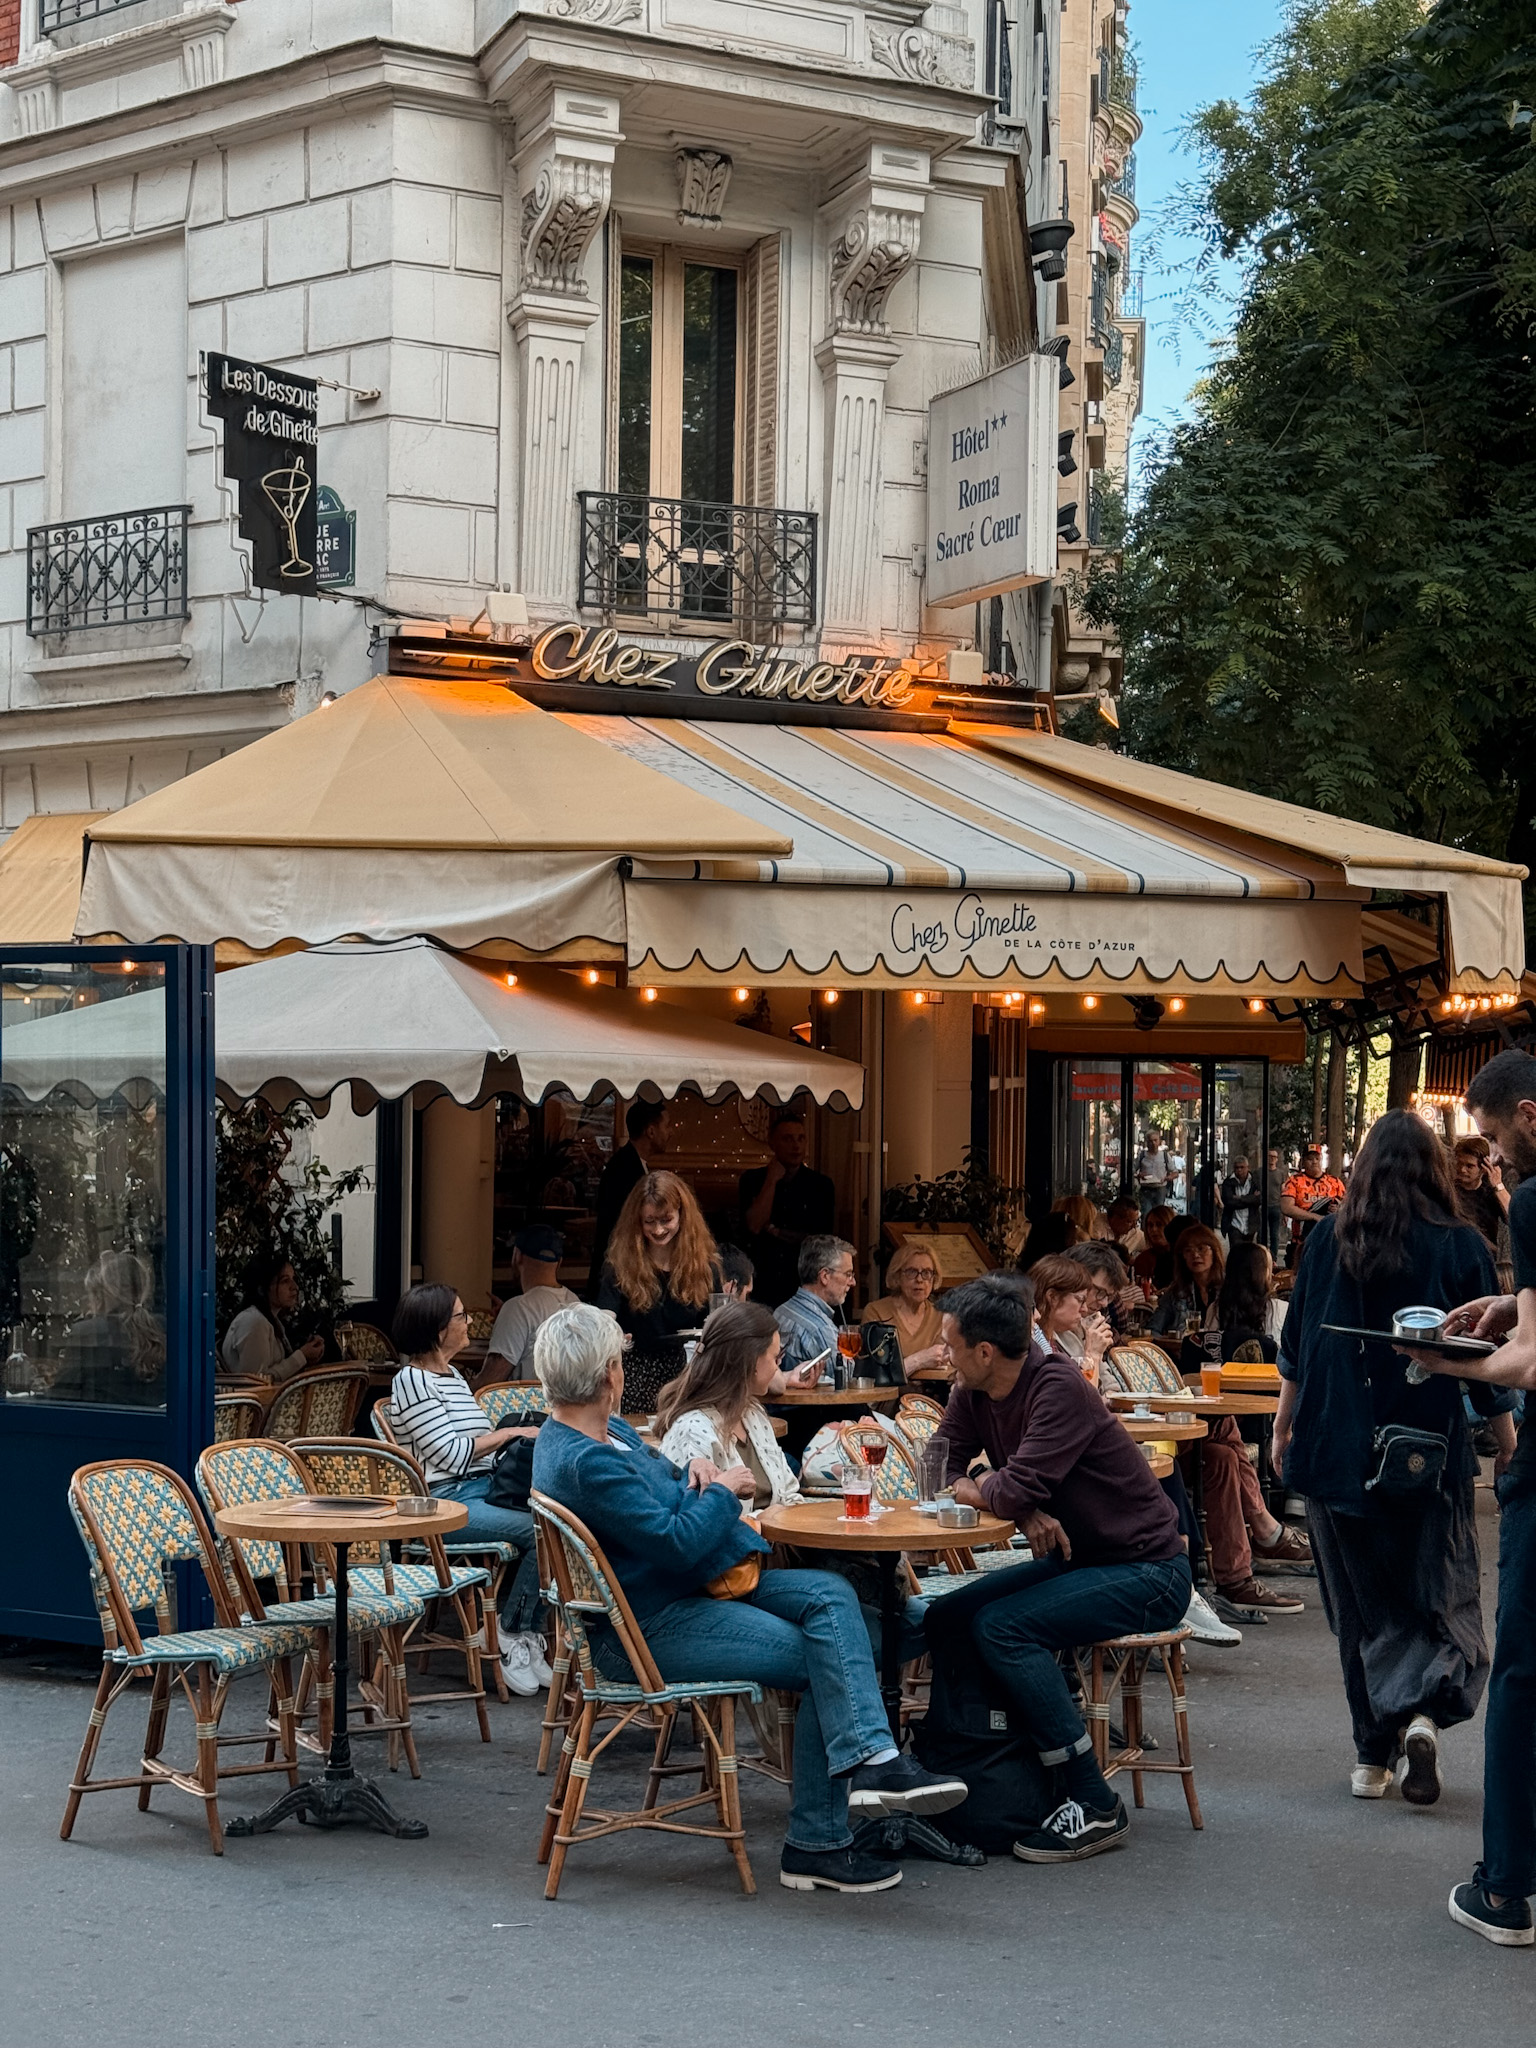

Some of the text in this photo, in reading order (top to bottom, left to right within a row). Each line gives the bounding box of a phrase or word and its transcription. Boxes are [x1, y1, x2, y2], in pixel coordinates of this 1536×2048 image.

[222, 360, 320, 412] Les Dessous
[246, 404, 320, 446] de Ginette
[951, 418, 989, 463] Hôtel
[957, 475, 1000, 511] Roma
[935, 512, 1021, 562] Sacré Cœur
[531, 620, 916, 709] Chez Ginette
[891, 893, 1037, 954] Chez Ginette
[1004, 938, 1136, 951] DE LA CÔTE D'AZUR
